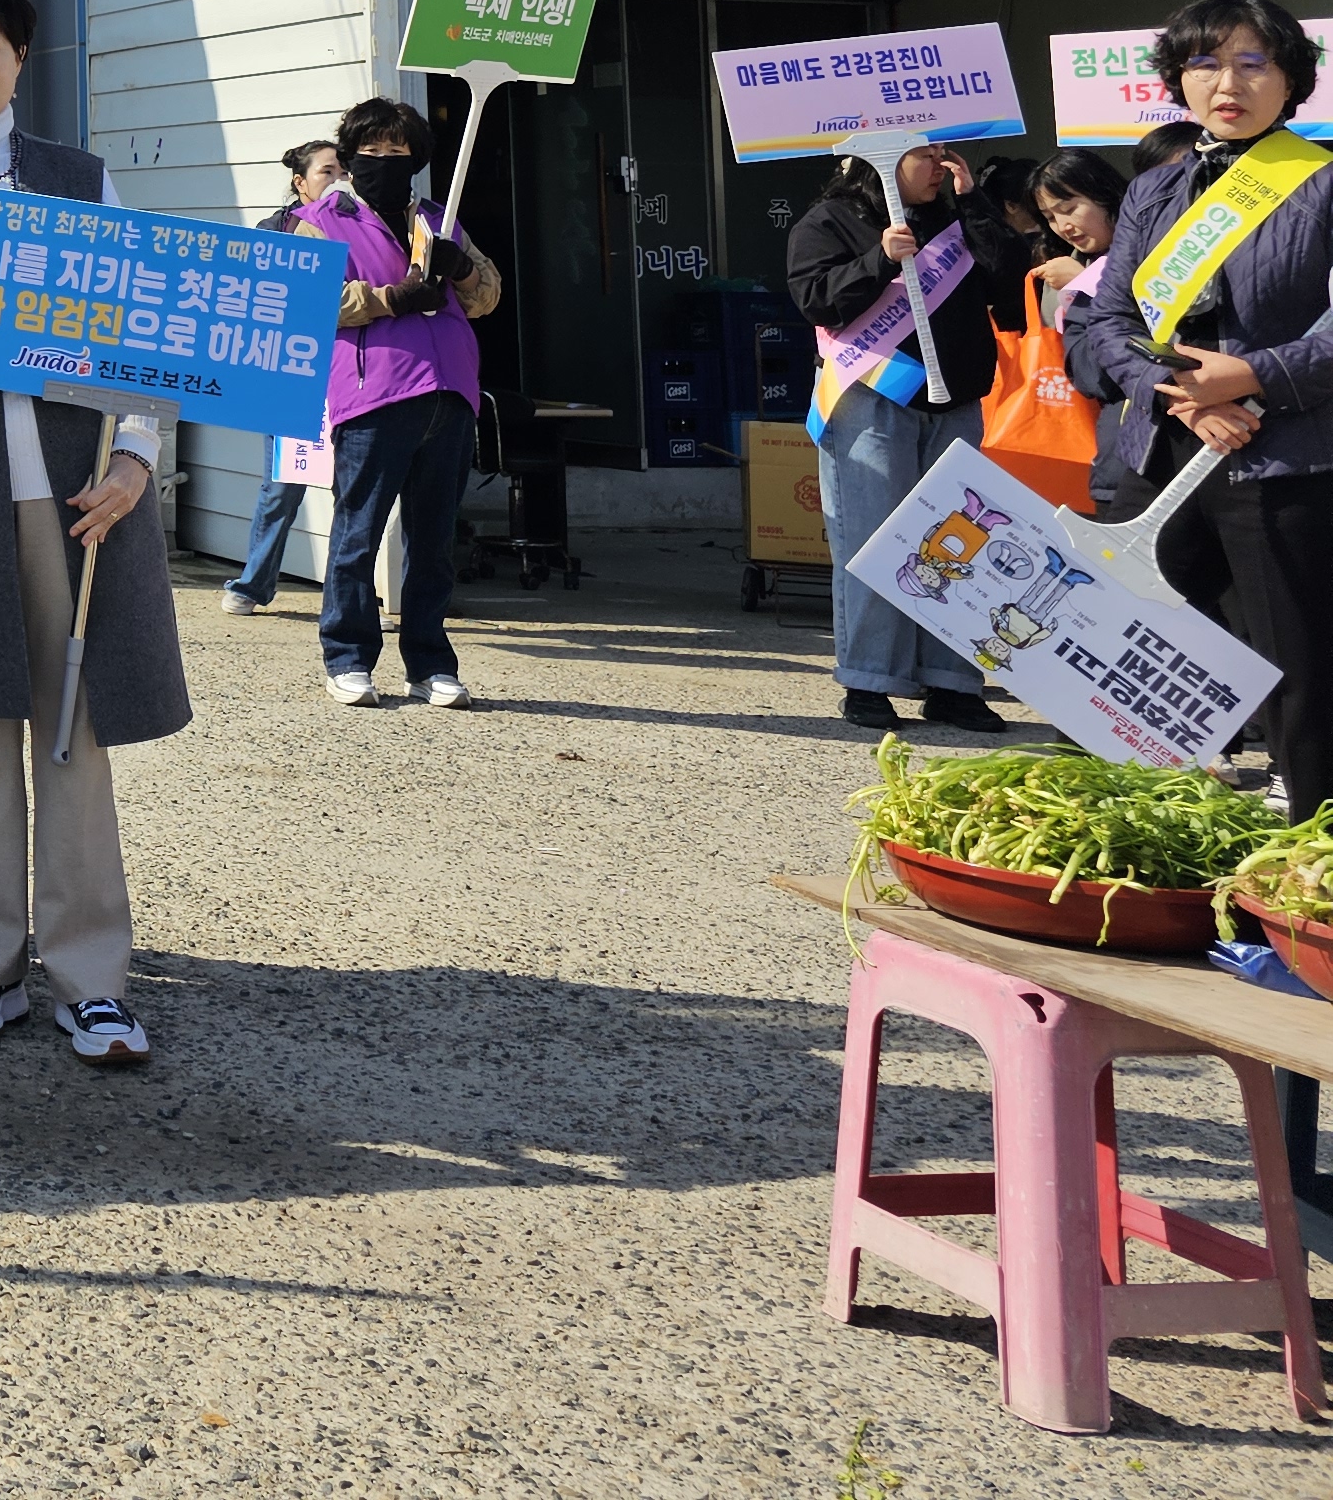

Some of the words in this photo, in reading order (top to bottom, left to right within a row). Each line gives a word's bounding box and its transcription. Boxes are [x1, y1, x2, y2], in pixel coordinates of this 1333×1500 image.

[462, 27, 491, 42] 진도군
[495, 30, 553, 47] 치매안심센터
[736, 57, 825, 87] 마음에도
[830, 45, 942, 78] 건강검진이
[879, 71, 992, 104] 필요합니다
[811, 116, 861, 134] Jindo
[875, 112, 937, 127] 진도군보건소
[1135, 109, 1182, 123] Jindo
[1226, 186, 1260, 210] 감염병
[1230, 167, 1282, 204] 진드기매개
[53, 211, 142, 249] 최적기는
[150, 225, 218, 262] 건강할
[226, 242, 320, 274] 때입니다
[1163, 207, 1238, 282] 야외활동
[636, 246, 708, 280] 니다
[55, 251, 167, 306] 지키는
[177, 269, 289, 325] 첫걸음
[1149, 280, 1172, 300] 후
[14, 289, 197, 357] 암검진으로
[209, 321, 319, 377] 하세요
[835, 328, 877, 368] 무료상담
[10, 344, 79, 375] Jindo
[98, 360, 223, 397] 진도군보건소
[1122, 619, 1241, 713] 뿌리고!
[1053, 636, 1206, 755] 갖춰입고!
[1115, 648, 1215, 735] 기피제
[1089, 695, 1142, 736] 않으려면
